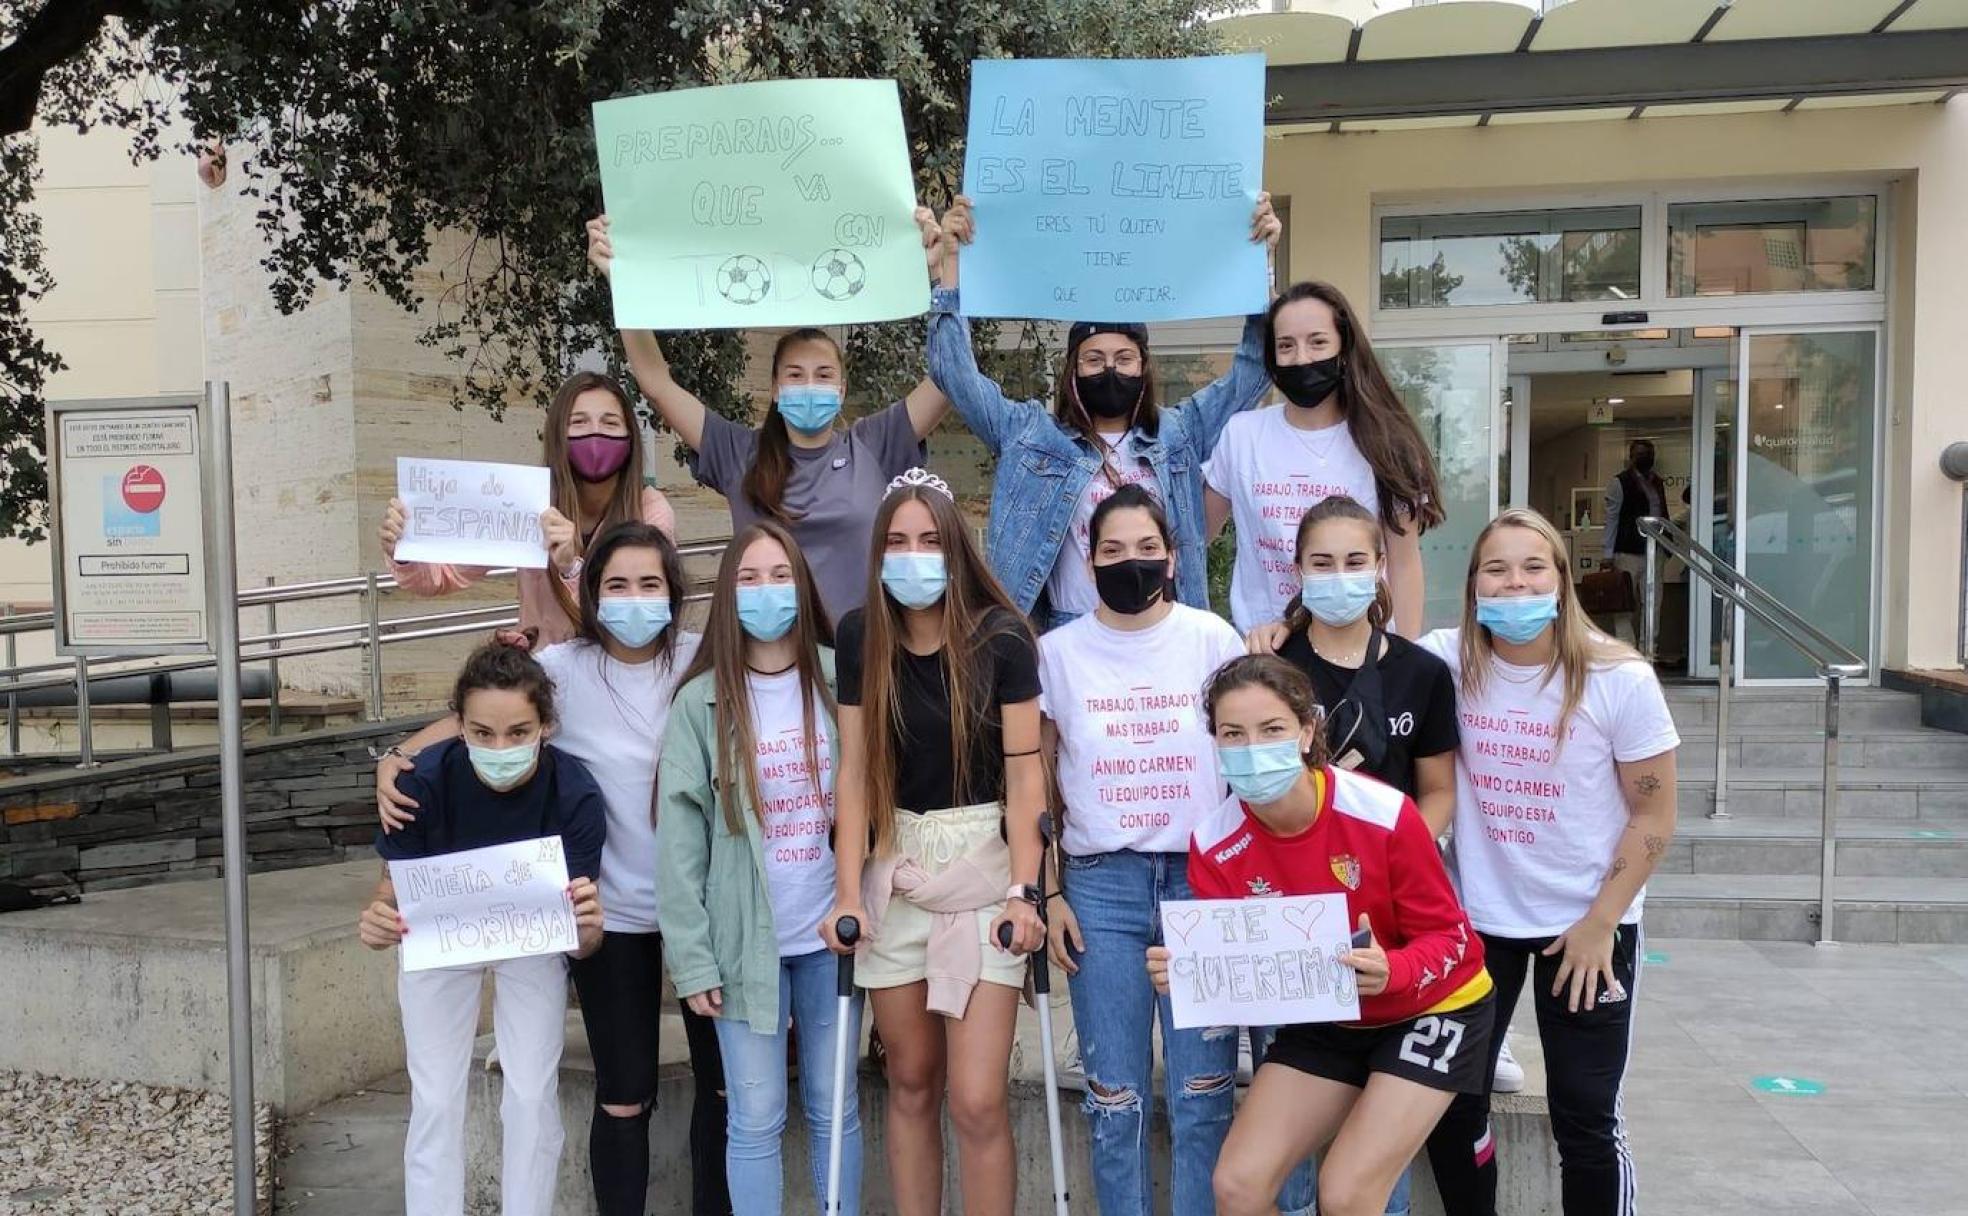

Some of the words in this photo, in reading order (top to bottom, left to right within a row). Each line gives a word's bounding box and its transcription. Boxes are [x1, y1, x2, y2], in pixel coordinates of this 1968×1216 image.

[991, 95, 1035, 136] LA
[1065, 95, 1207, 139] MENTE
[976, 157, 1026, 194] ES
[1041, 159, 1090, 195] EL
[1111, 161, 1245, 200] LIMITE
[691, 181, 764, 226] QUE
[793, 174, 831, 201] VA
[835, 213, 885, 247] CON
[1036, 215, 1072, 233] ERES
[1119, 217, 1165, 234] QUIEN
[1083, 251, 1132, 267] TIENE
[1053, 286, 1079, 302] QUE
[413, 501, 541, 544] ESPAÑA
[101, 560, 139, 570] Prohibido
[141, 560, 167, 570] fumar
[1086, 698, 1138, 713] TRABAJO,
[1140, 695, 1189, 711] TRABAJO
[1191, 694, 1199, 708] Y
[1130, 719, 1180, 737] TRABAJO
[1568, 727, 1577, 741] Y
[1501, 744, 1550, 764] TRABAJO
[787, 757, 832, 775] TRABJO
[1098, 788, 1113, 802] TU
[1116, 786, 1159, 802] EQUIPO
[1162, 780, 1191, 799] ESTÁ
[761, 797, 794, 816] NIMO
[1481, 801, 1523, 820] EQUIPO
[775, 821, 813, 838] EQUIPO
[1120, 813, 1170, 829] CONTIGO
[775, 847, 822, 863] CONTIGO
[1212, 905, 1268, 943] TE
[1398, 1015, 1467, 1074] 27
